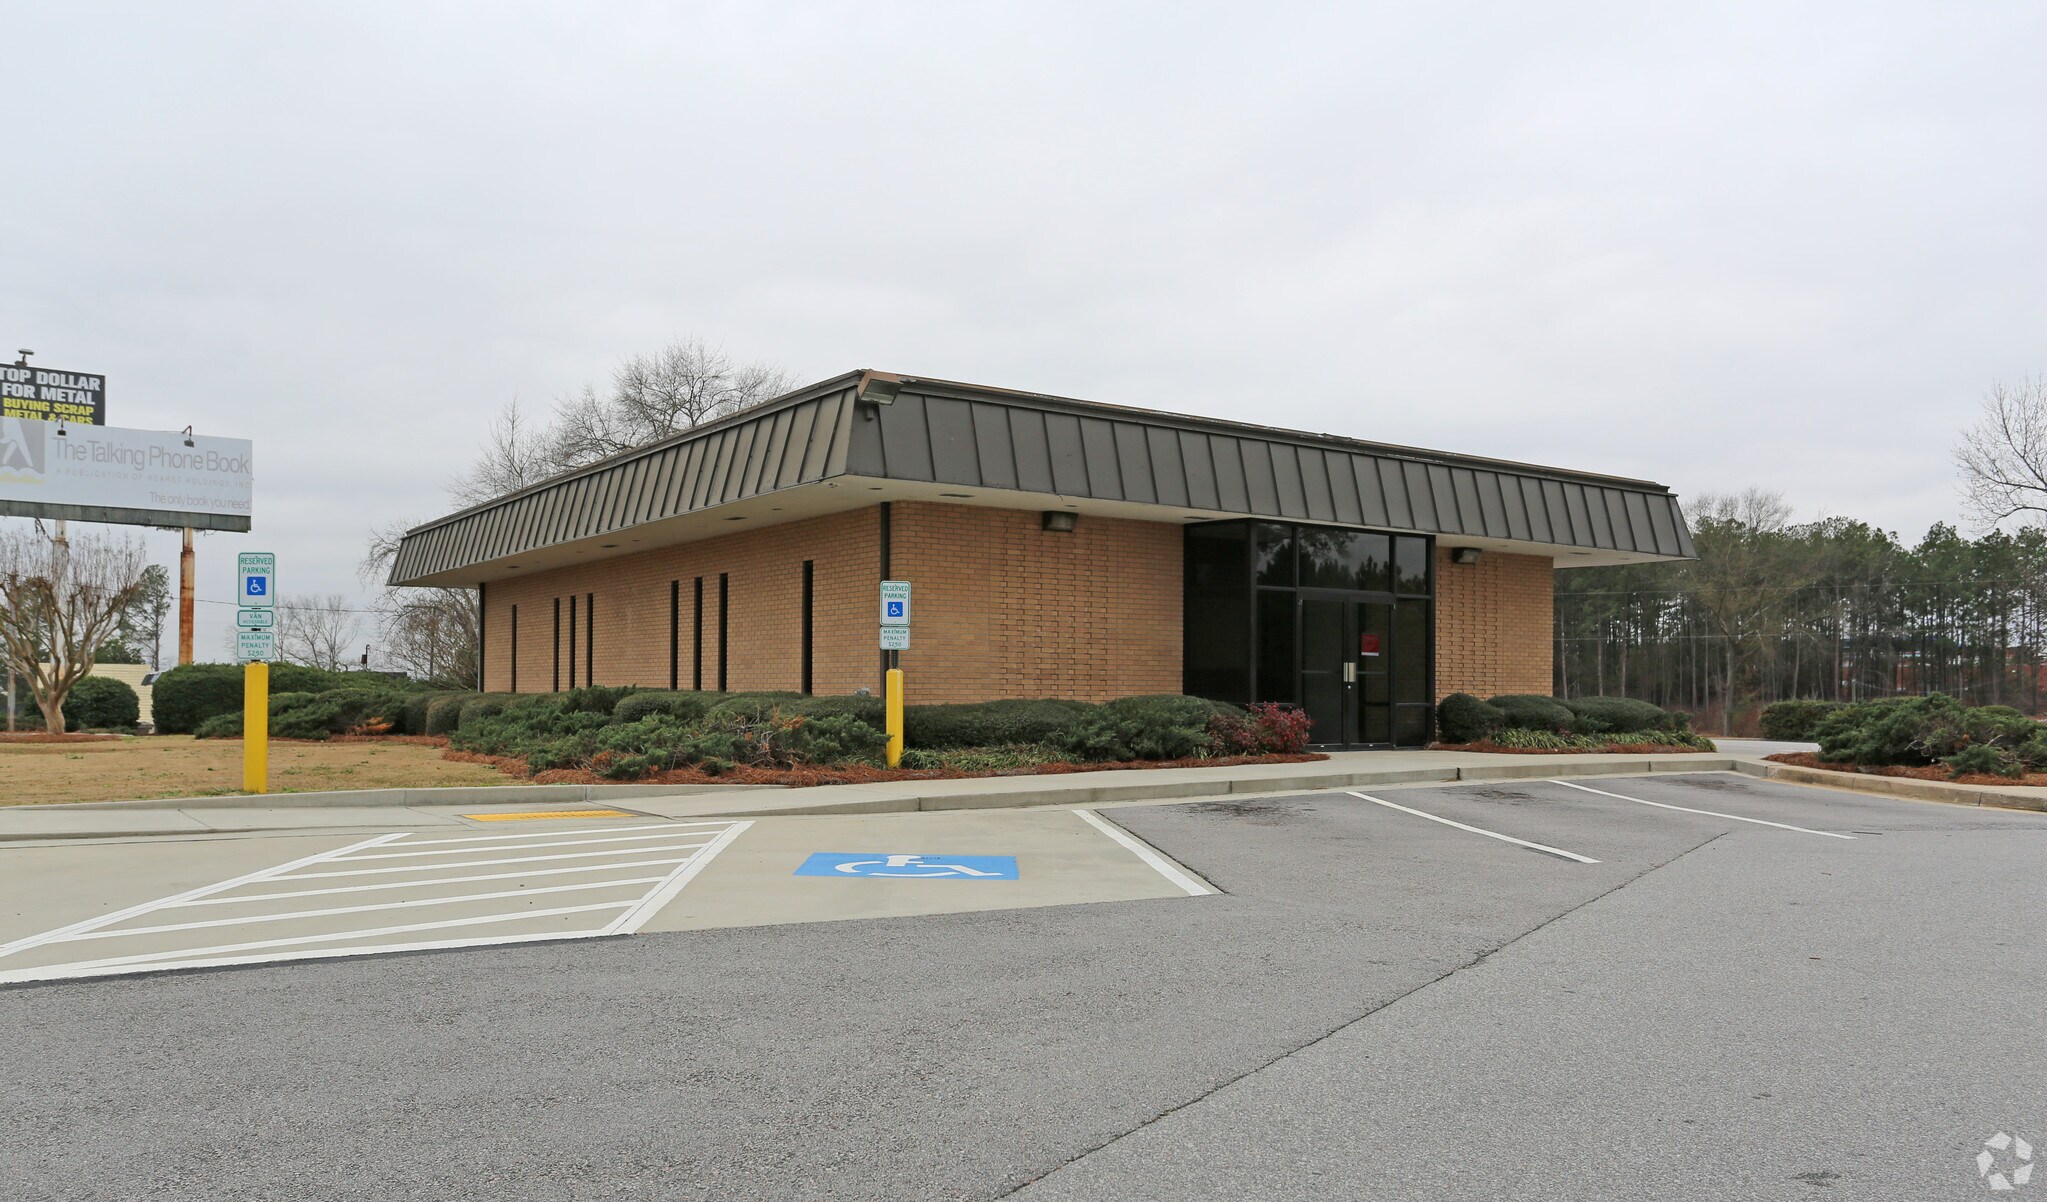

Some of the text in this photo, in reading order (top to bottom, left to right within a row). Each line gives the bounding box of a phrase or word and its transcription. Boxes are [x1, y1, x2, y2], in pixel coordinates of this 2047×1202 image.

[0, 367, 101, 391] TOP DOLLAR
[2, 382, 96, 405] FOR METAL
[3, 398, 95, 416] BUYING SCRAP
[4, 409, 94, 425] METAL & CARS
[52, 437, 87, 461] The
[87, 440, 145, 471] Talking
[149, 445, 204, 470] Phone
[65, 468, 128, 480] PUBLICATION
[147, 475, 182, 484] HEARST
[149, 491, 166, 504] The
[168, 494, 185, 508] only
[187, 495, 209, 506] book
[210, 498, 227, 510] you
[240, 557, 273, 565] RESERVED
[242, 567, 271, 575] PARKING
